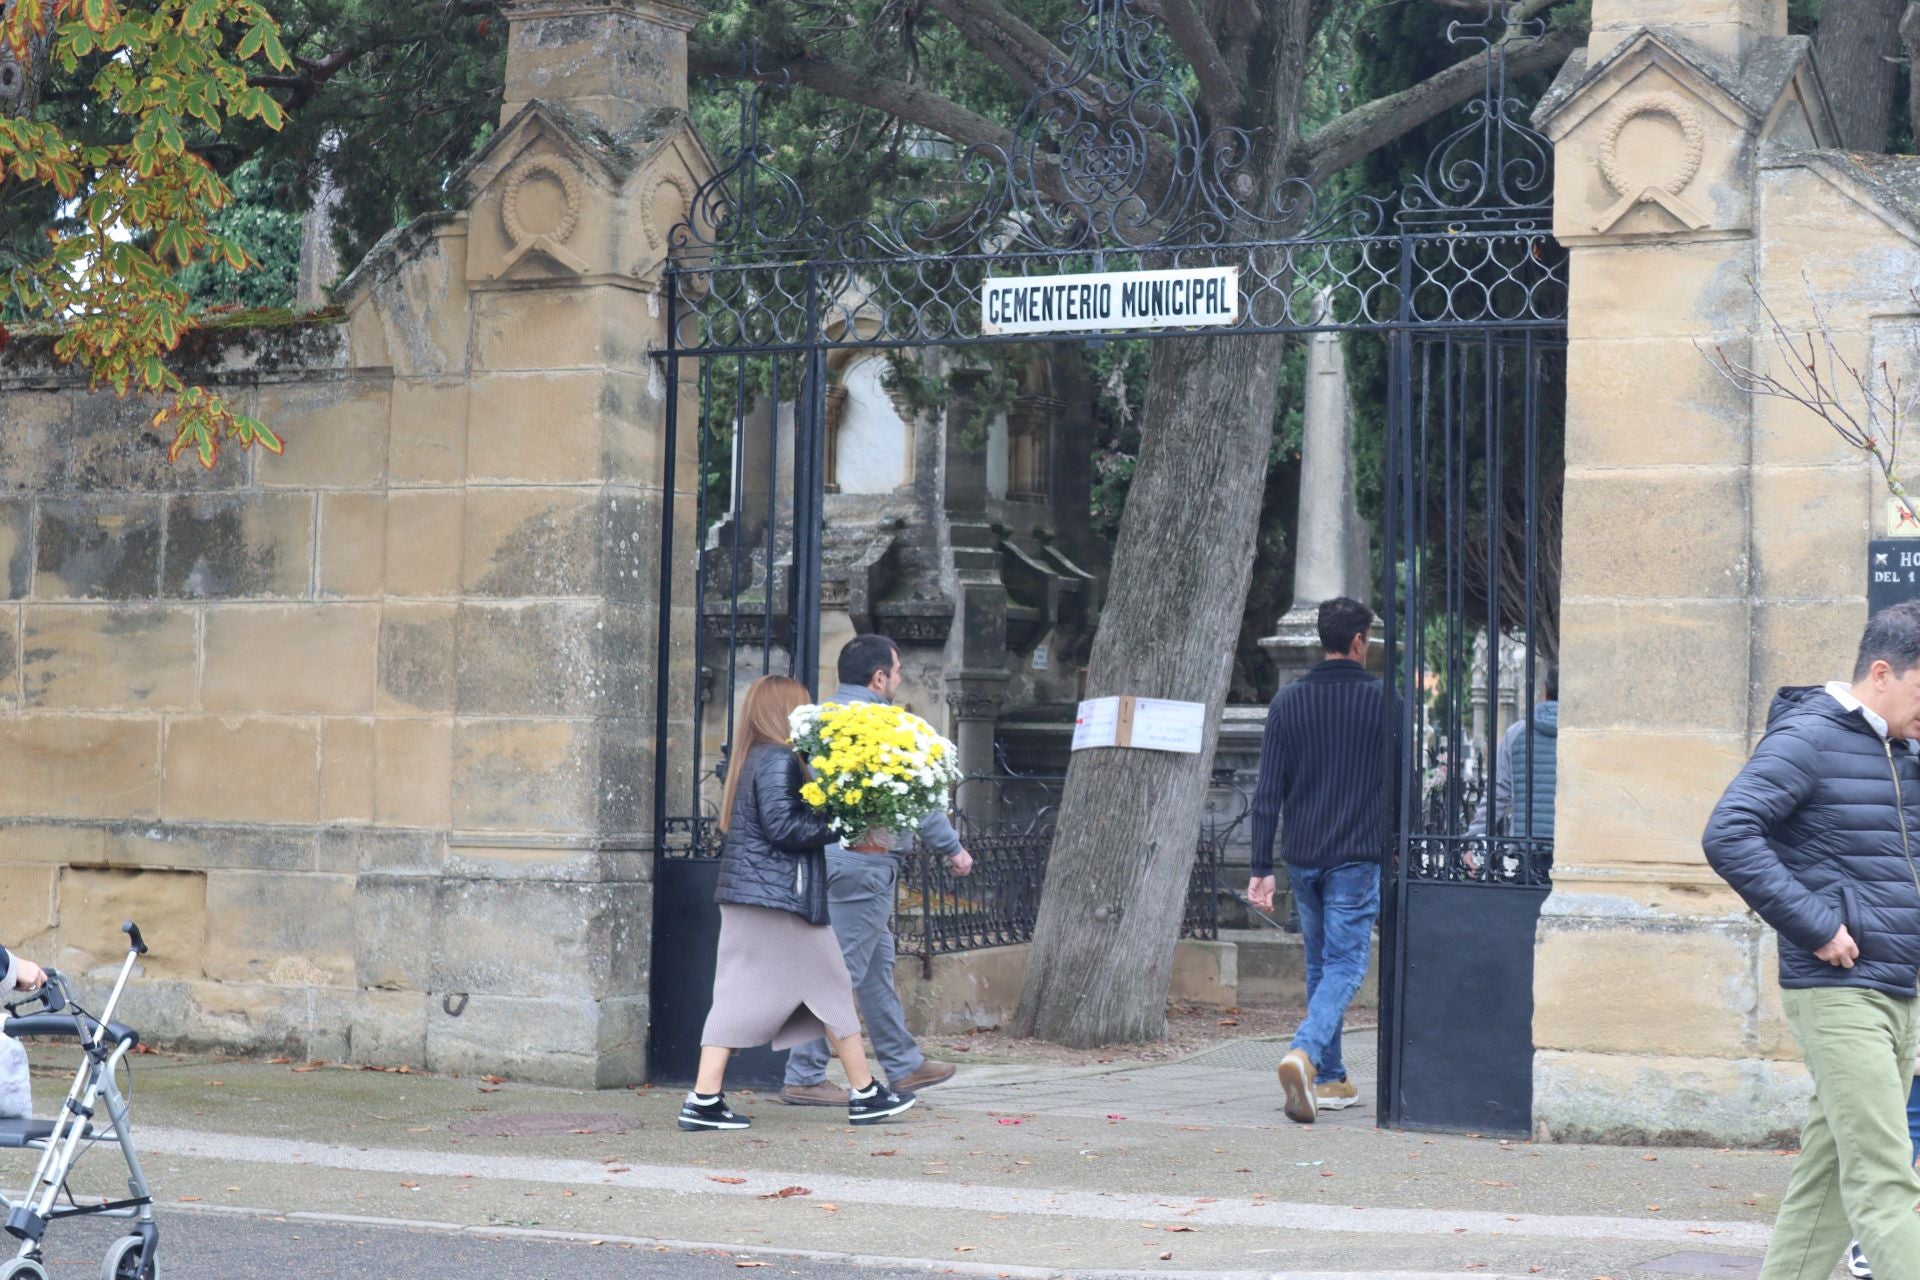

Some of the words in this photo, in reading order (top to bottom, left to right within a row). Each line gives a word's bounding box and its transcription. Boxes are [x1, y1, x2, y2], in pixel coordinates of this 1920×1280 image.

[989, 283, 1111, 324] CEMENTERIO
[1122, 276, 1231, 317] MUNICIPAL
[1874, 571, 1900, 582] DEL
